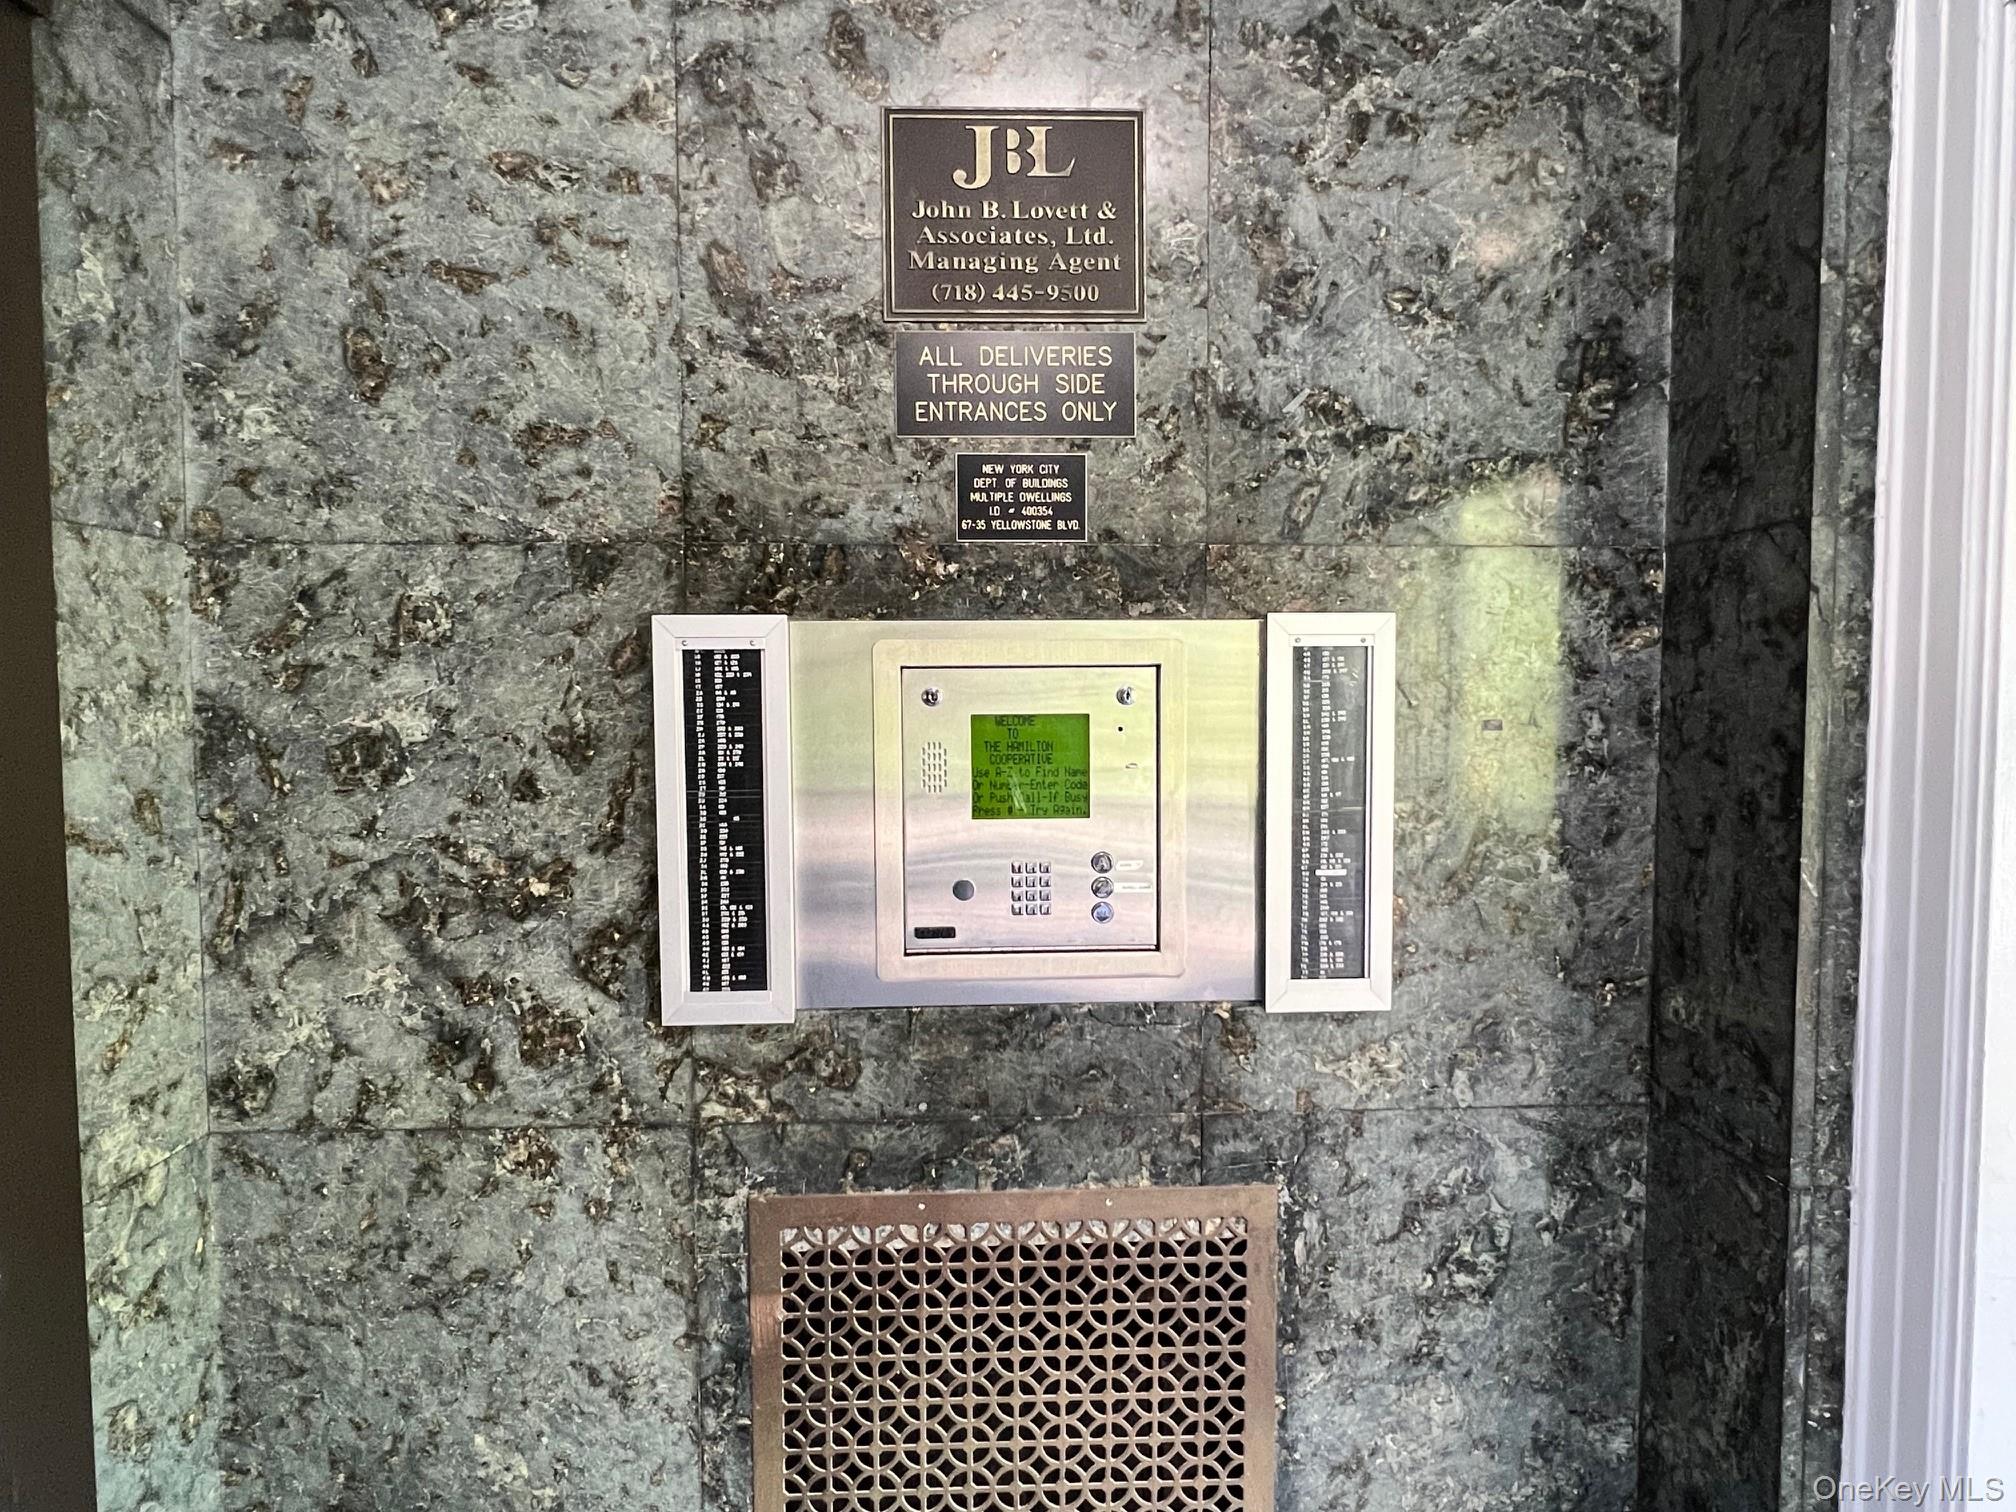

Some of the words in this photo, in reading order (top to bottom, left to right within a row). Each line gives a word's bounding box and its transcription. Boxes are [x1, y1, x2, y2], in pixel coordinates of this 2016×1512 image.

[952, 125, 1076, 190] JBL
[912, 200, 972, 219] John
[980, 200, 1006, 219] B.
[1012, 200, 1089, 219] Lovett
[1097, 200, 1117, 220] &
[917, 226, 1056, 248] Associates,
[1065, 226, 1114, 246] Ltd.
[908, 251, 1039, 274] Managing
[1048, 252, 1121, 274] Agent
[932, 282, 986, 304] (718)
[992, 284, 1100, 302] 445-9500
[918, 345, 963, 367] ALL
[979, 345, 1113, 367] DELIVERIES
[927, 373, 1039, 394] THROUGH
[1055, 373, 1105, 394] SIDE
[915, 401, 1047, 422] ENTRANCES
[1061, 401, 1118, 422] ONLY
[981, 464, 1005, 475] NEW
[1009, 464, 1034, 475] YORK
[1038, 464, 1060, 475] CITY
[973, 477, 997, 489] DEPT
[1004, 477, 1017, 489] OF
[1021, 477, 1069, 489] BUILDINGS
[969, 491, 1014, 503] MULTIPLE
[1019, 491, 1073, 503] DWELLINGS
[1021, 505, 1054, 517] 400354
[961, 519, 987, 531] 67-35
[990, 519, 1053, 531] YELLOWSTONE
[994, 715, 1036, 727] WELCOME
[1007, 727, 1020, 740] TO
[984, 740, 1002, 753] THE
[1006, 740, 1054, 753] HAMILTON
[989, 753, 1054, 766] COOPERATIVE
[972, 767, 990, 778] Use
[1019, 766, 1031, 778] to
[1035, 766, 1060, 778] Find
[1064, 766, 1088, 778] Name
[972, 779, 984, 791] Or
[989, 779, 1060, 791] Numr-Enter
[989, 791, 1014, 804] Push
[1064, 791, 1088, 803] Busy
